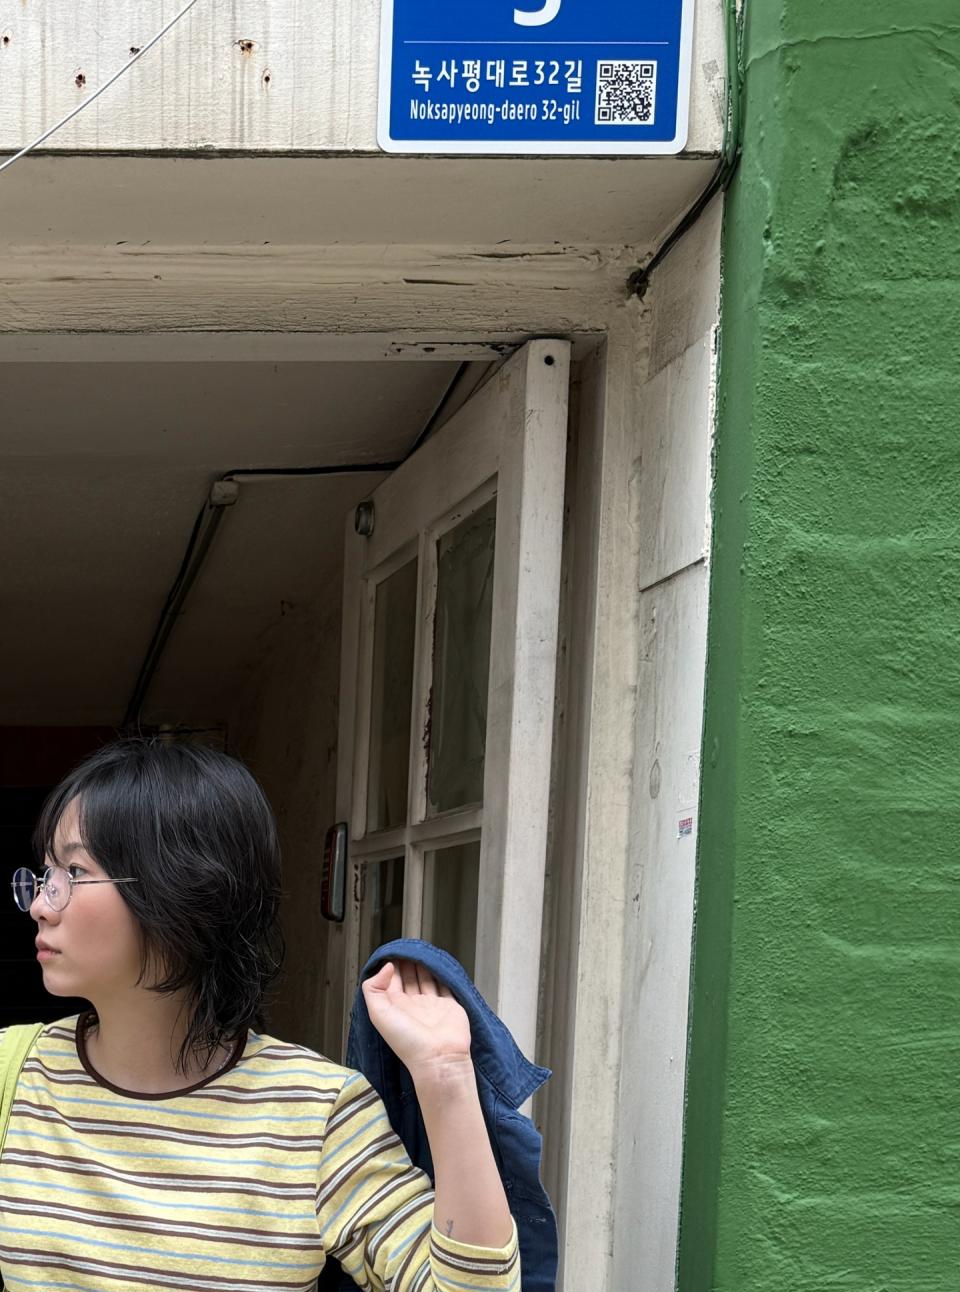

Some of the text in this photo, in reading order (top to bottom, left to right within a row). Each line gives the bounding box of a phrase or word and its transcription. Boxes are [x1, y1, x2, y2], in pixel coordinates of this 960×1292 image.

[411, 59, 582, 93] 녹사평대로32길
[410, 99, 580, 125] Noksapyeong-daero 32-gil
